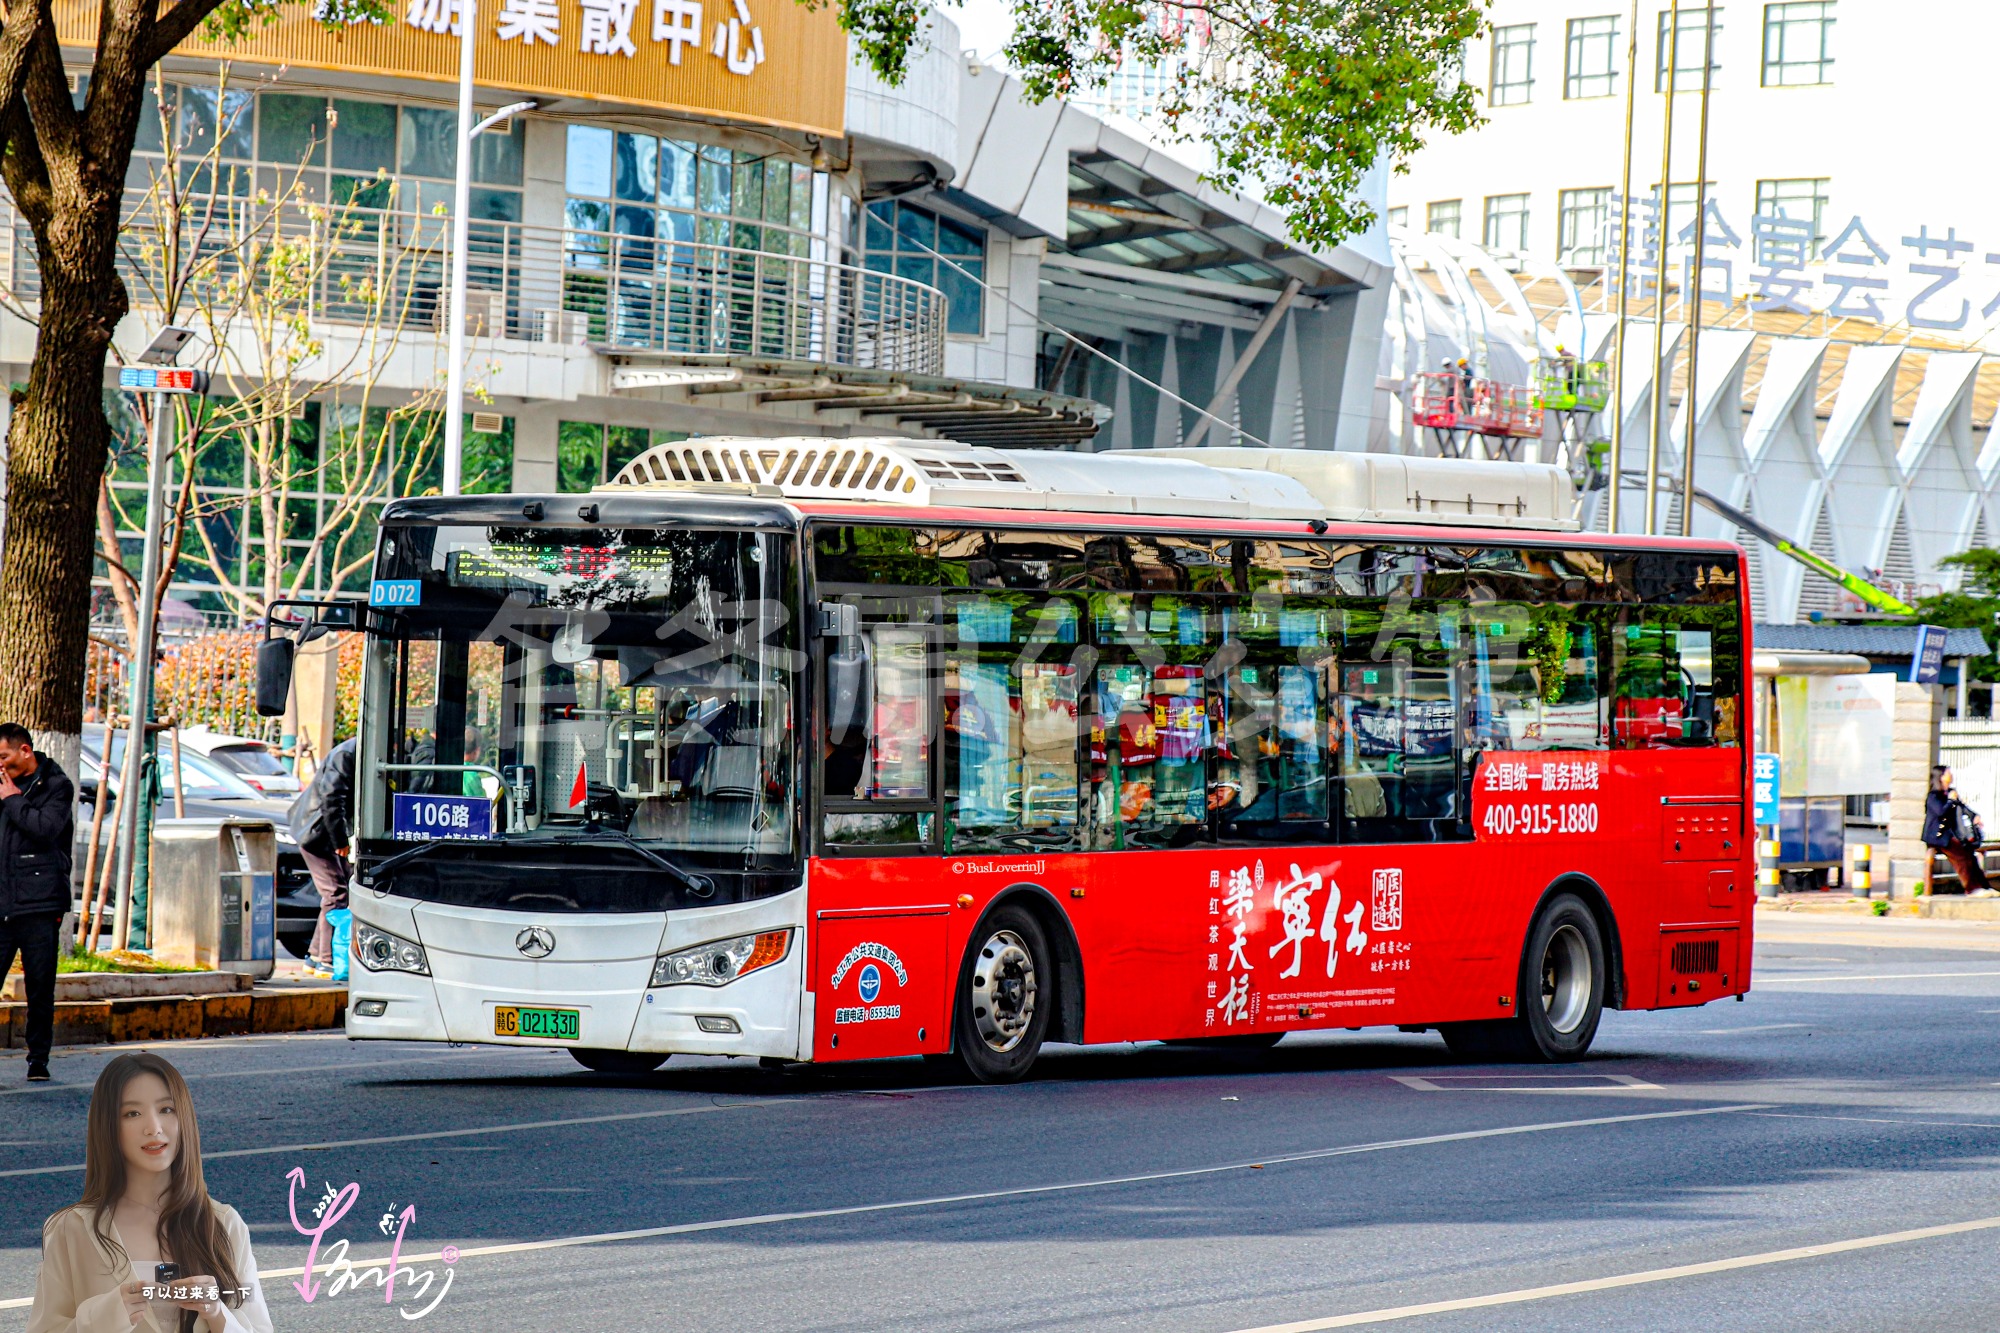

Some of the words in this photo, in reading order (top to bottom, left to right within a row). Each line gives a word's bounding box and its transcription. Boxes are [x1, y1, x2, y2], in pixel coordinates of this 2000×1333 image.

[374, 585, 386, 603] D
[388, 584, 416, 603] 072
[1484, 762, 1600, 791] 全国统一服务热线
[412, 802, 470, 828] 106路
[1483, 803, 1599, 835] 400-915-1880
[1205, 870, 1220, 1027] 用红茶观世界
